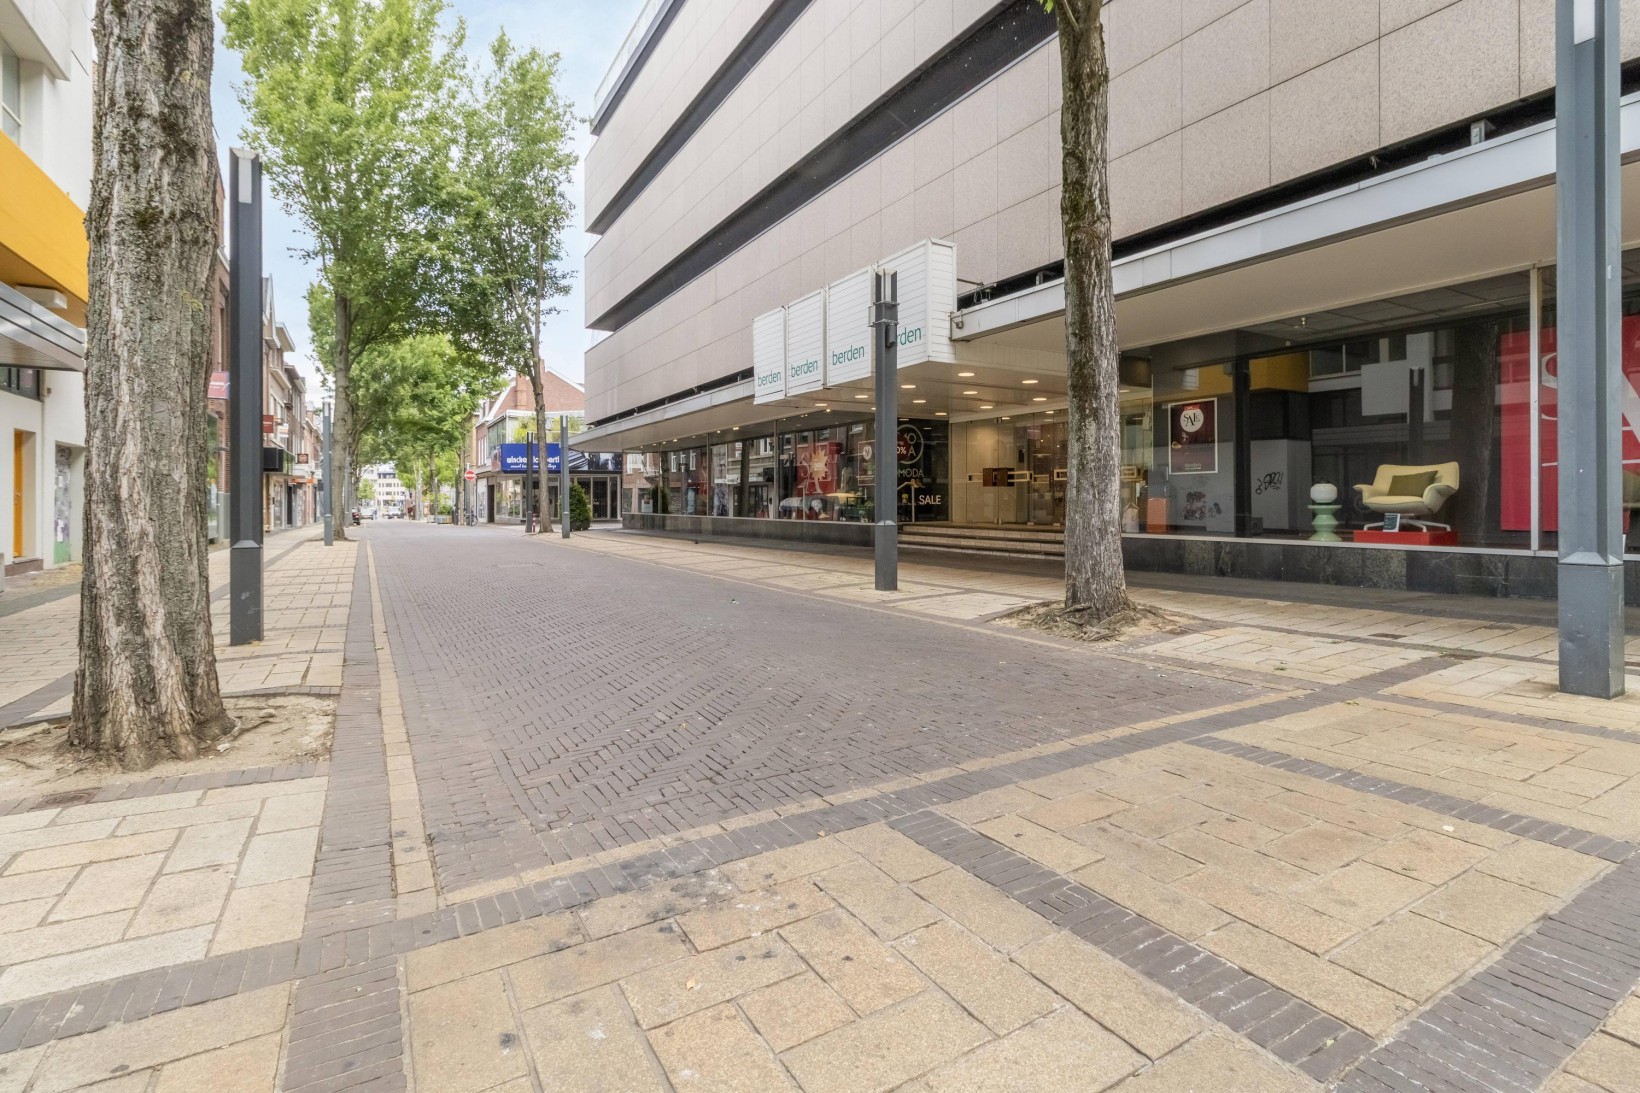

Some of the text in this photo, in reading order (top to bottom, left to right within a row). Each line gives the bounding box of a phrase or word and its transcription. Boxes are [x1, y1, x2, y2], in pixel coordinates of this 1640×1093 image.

[897, 326, 922, 346] rden
[832, 345, 865, 366] berden
[790, 359, 818, 378] berden
[757, 370, 781, 387] berden
[897, 468, 924, 478] MODA
[918, 494, 942, 505] SALE
